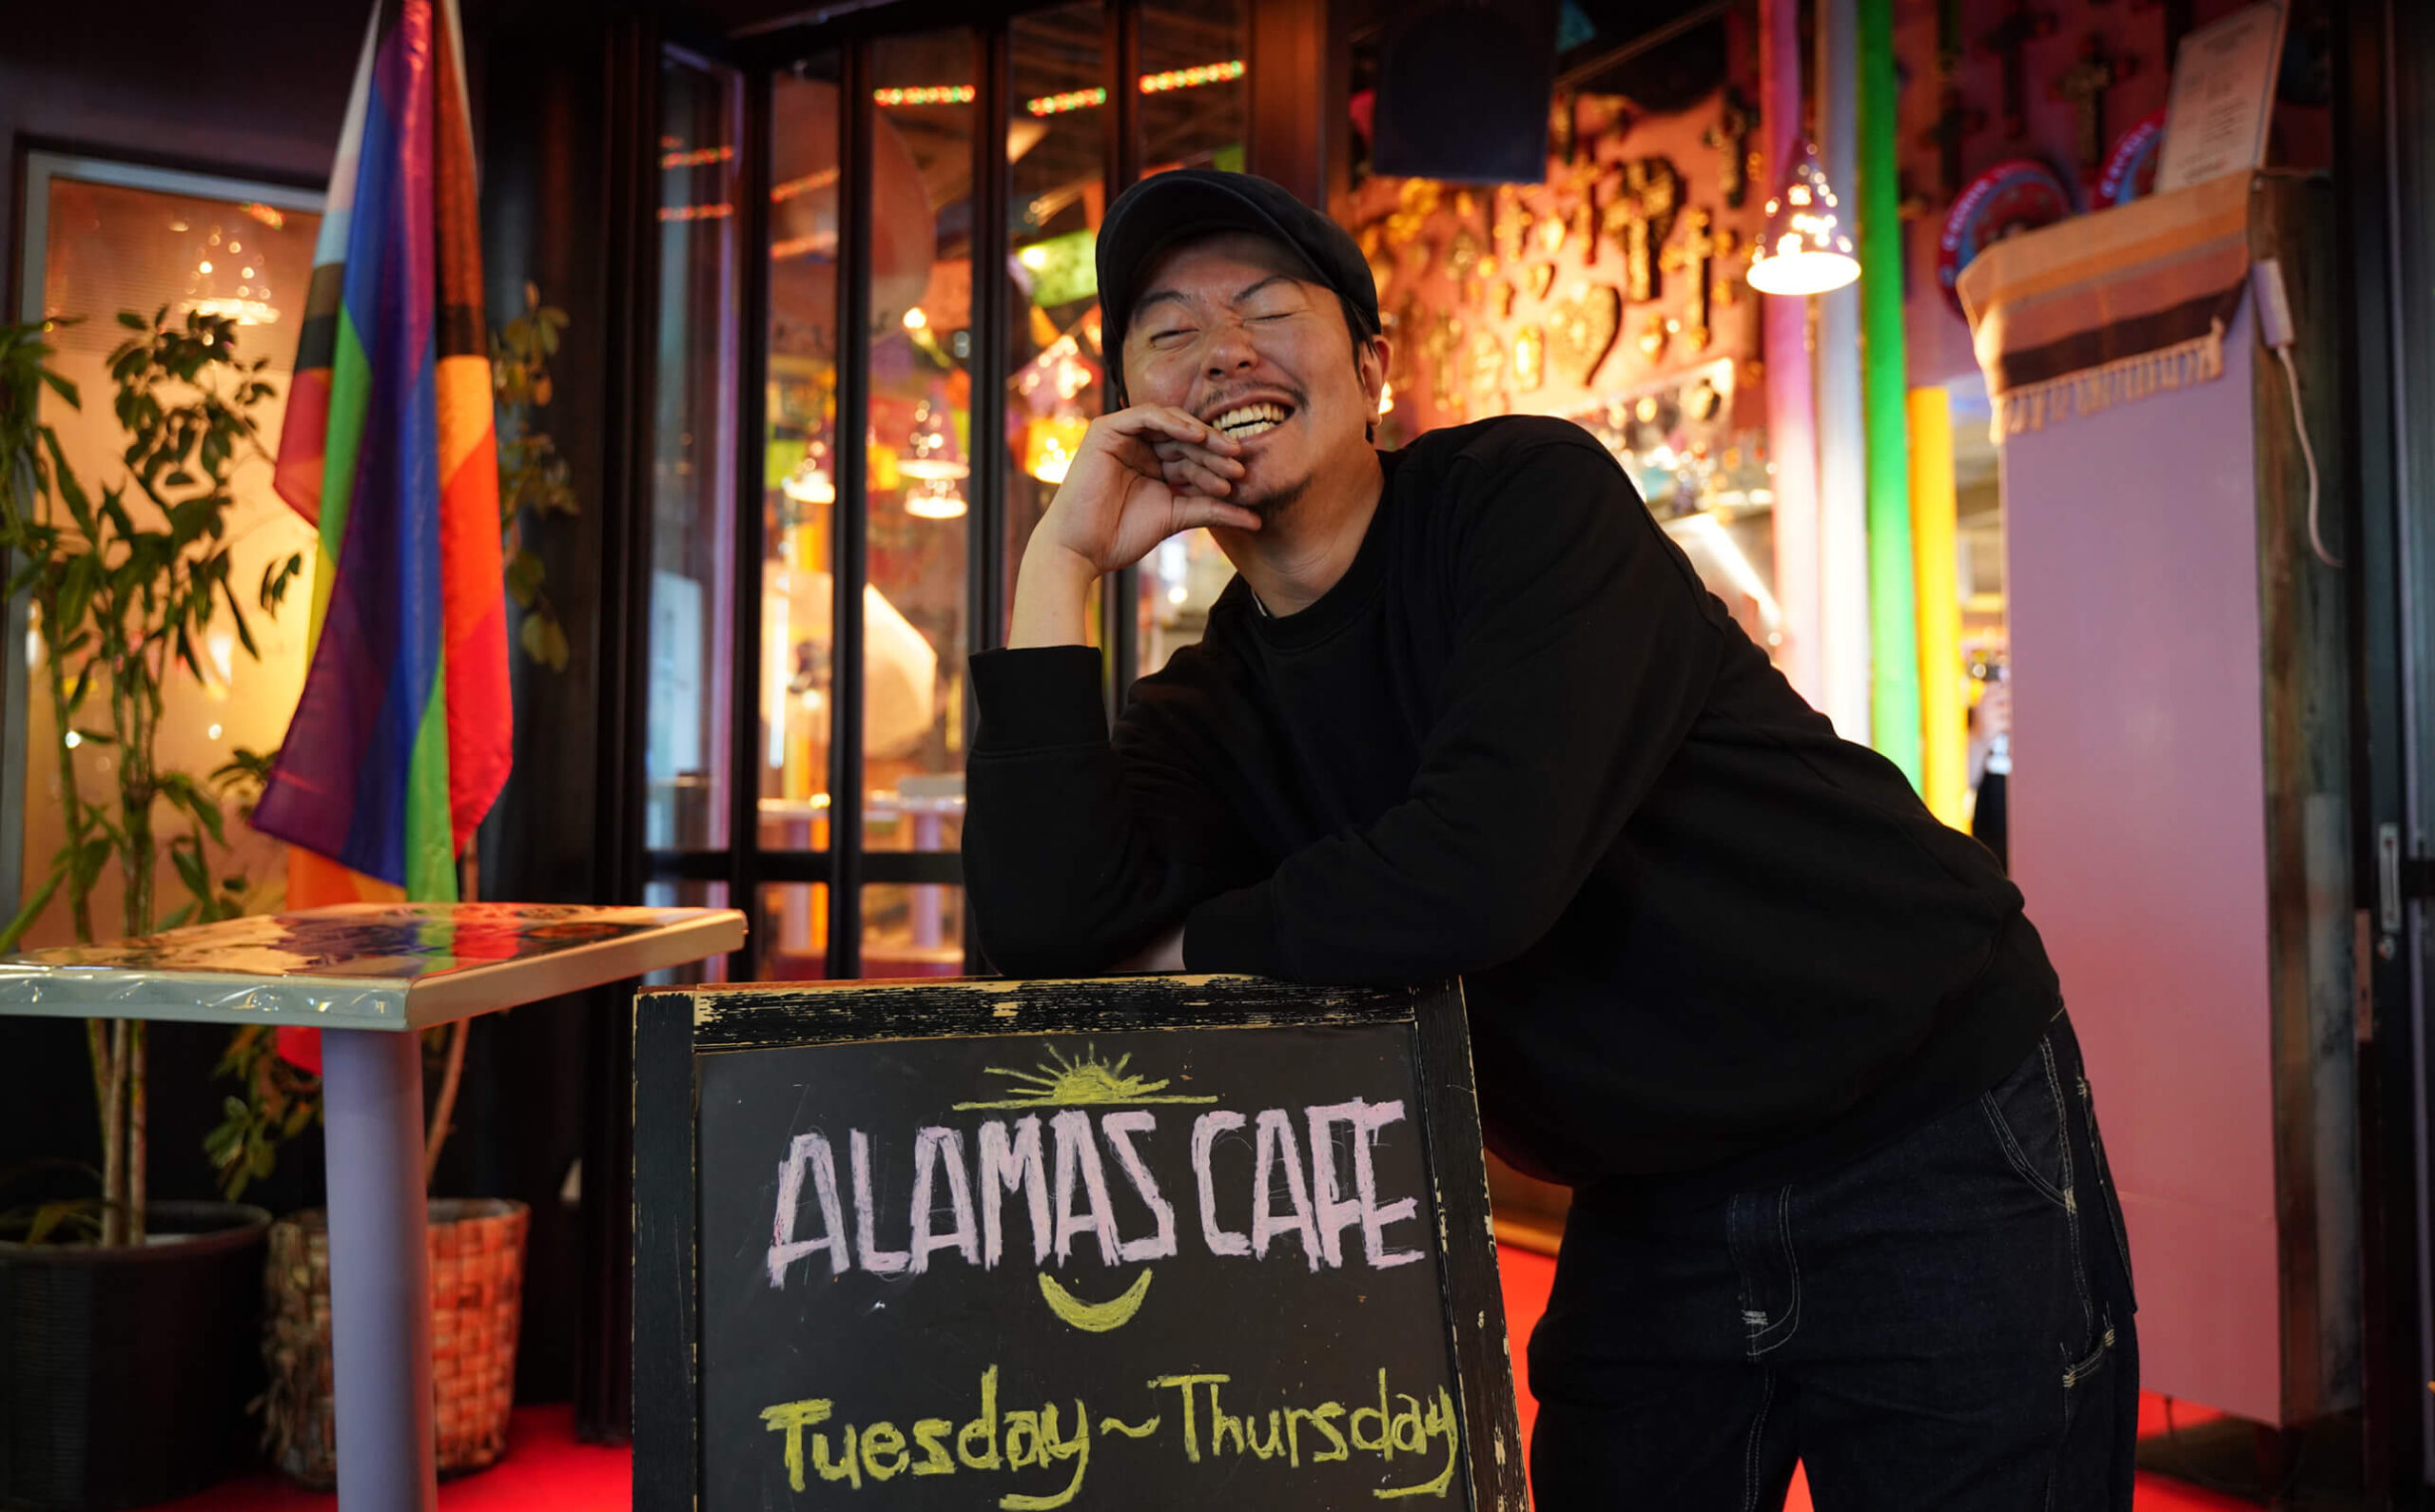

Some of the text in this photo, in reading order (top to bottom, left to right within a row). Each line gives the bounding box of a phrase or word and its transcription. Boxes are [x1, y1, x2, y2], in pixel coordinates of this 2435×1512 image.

[767, 1097, 1425, 1288] ALAMAS CAFE
[759, 1364, 1091, 1511] Tuesday
